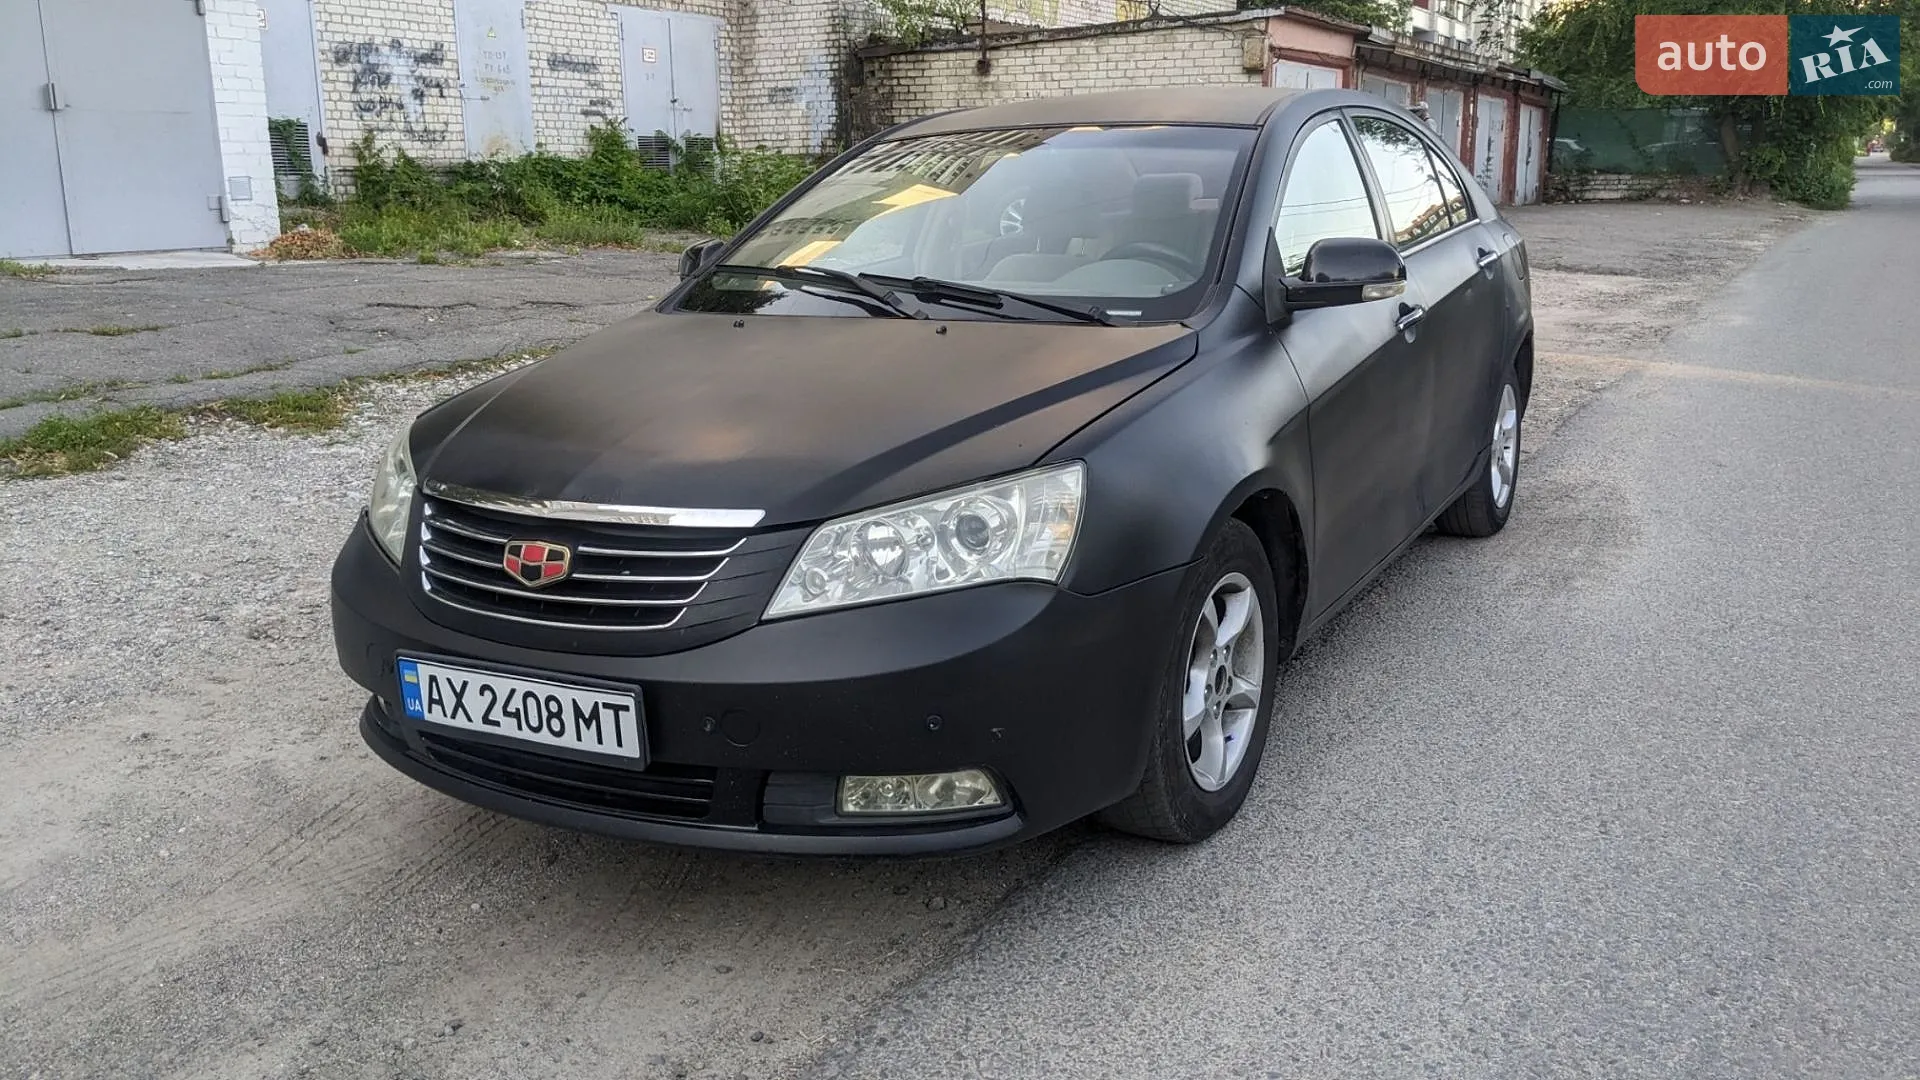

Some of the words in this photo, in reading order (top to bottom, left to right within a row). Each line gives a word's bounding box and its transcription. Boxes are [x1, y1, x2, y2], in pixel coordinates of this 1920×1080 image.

[407, 698, 422, 712] UA
[427, 674, 473, 723] AX
[479, 683, 566, 738] 2408
[572, 698, 630, 748] MT
